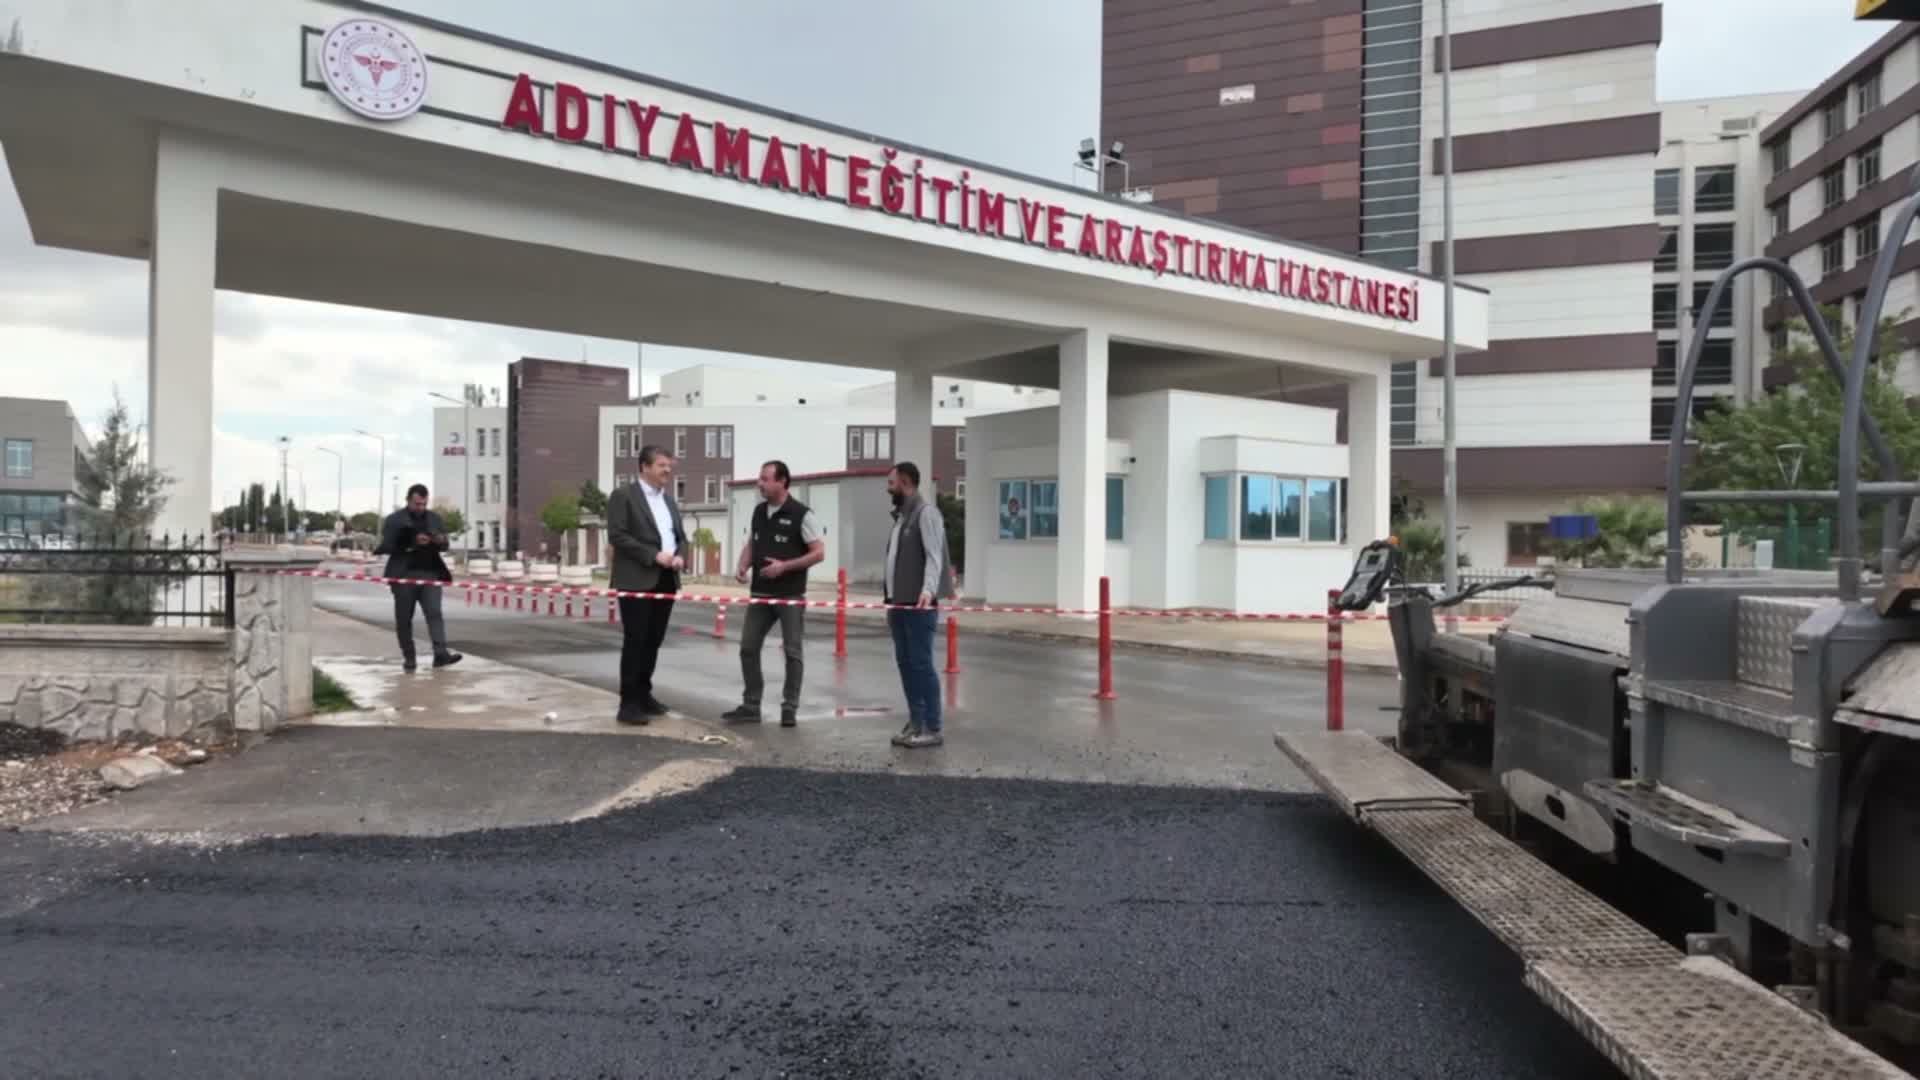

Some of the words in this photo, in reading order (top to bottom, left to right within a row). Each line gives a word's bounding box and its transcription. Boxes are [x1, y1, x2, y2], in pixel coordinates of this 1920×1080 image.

[503, 73, 827, 198] ADIYAMAN
[847, 148, 1005, 238] EĞİTİM
[1019, 197, 1066, 249] VE
[1078, 213, 1269, 292] ARAŞTIRMA
[1275, 258, 1419, 321] HASTANESİ
